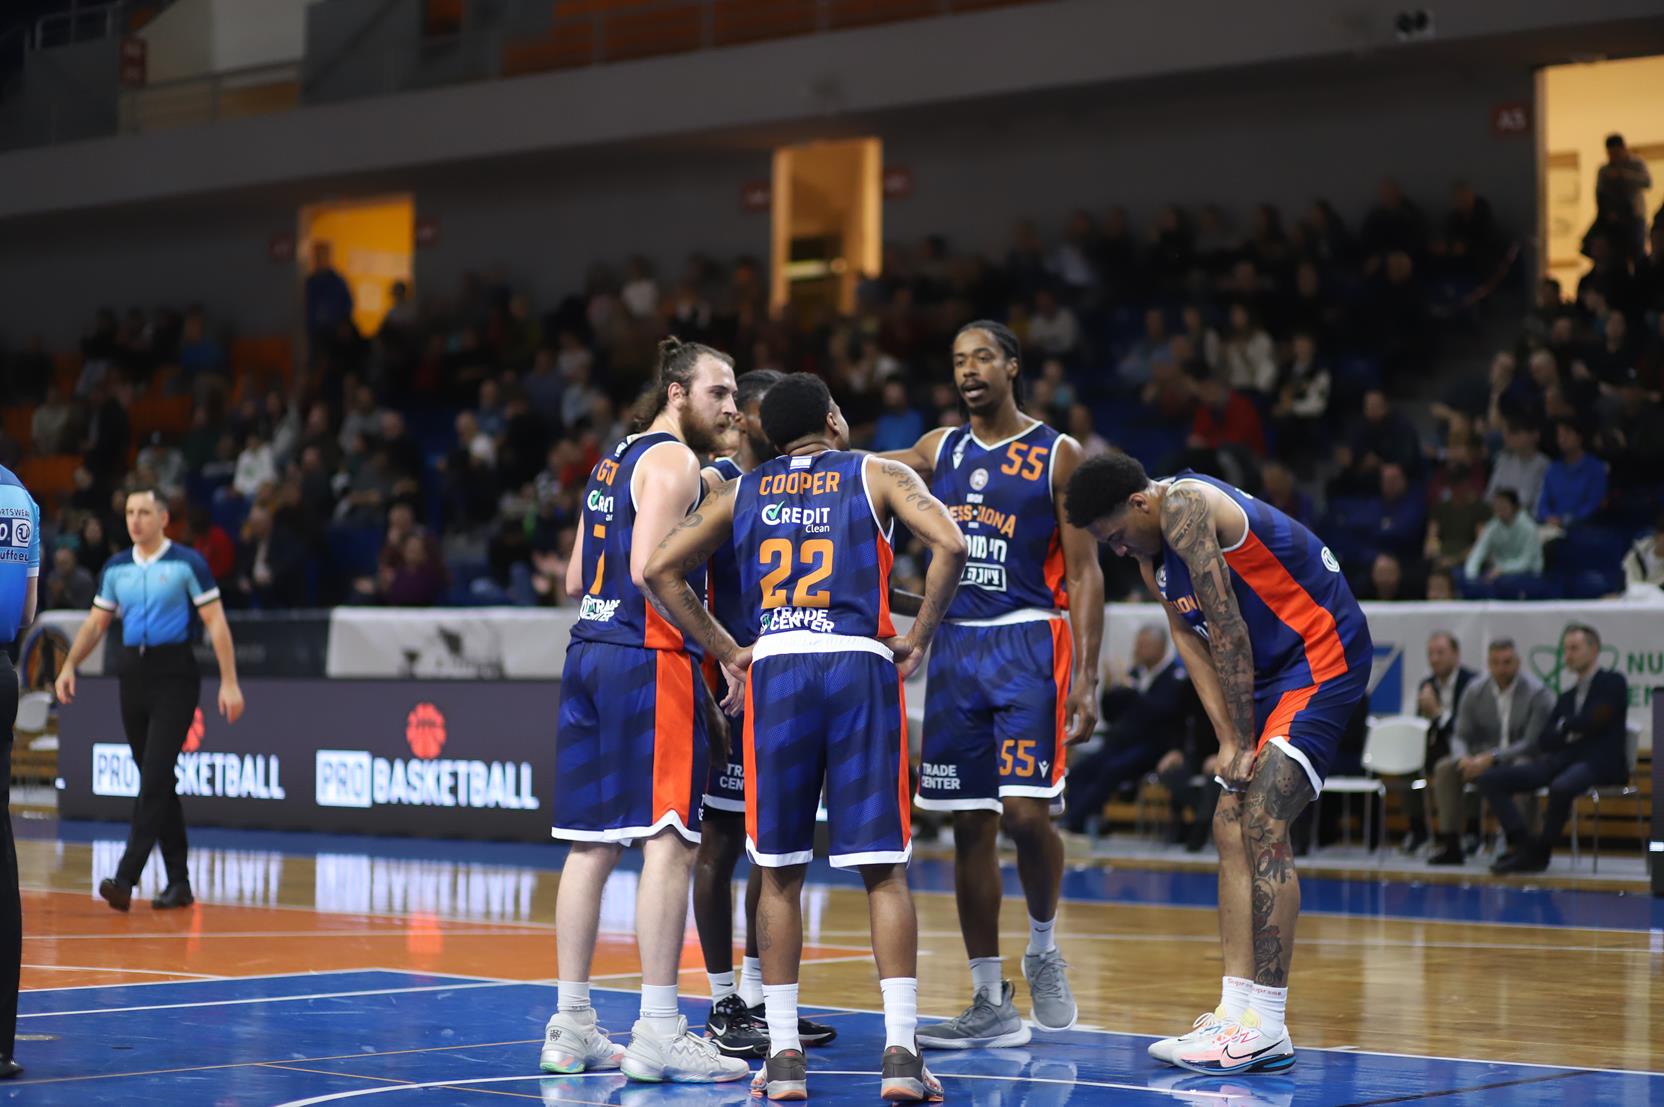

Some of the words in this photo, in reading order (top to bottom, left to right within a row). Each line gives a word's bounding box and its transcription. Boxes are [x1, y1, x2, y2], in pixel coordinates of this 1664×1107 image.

[1001, 441, 1049, 481] 55
[759, 471, 840, 496] COOPER
[762, 502, 830, 525] CREDIT
[946, 505, 973, 522] ESS
[805, 523, 830, 534] Clean
[759, 538, 834, 610] 22
[773, 606, 828, 621] TRADE
[922, 763, 957, 777] TRADE
[1000, 739, 1036, 777] 55
[96, 751, 137, 790] PRO
[174, 752, 287, 800] SKETBALL
[320, 757, 367, 801] PRO
[373, 757, 540, 809] BASKETBALL
[921, 777, 960, 790] CENTER
